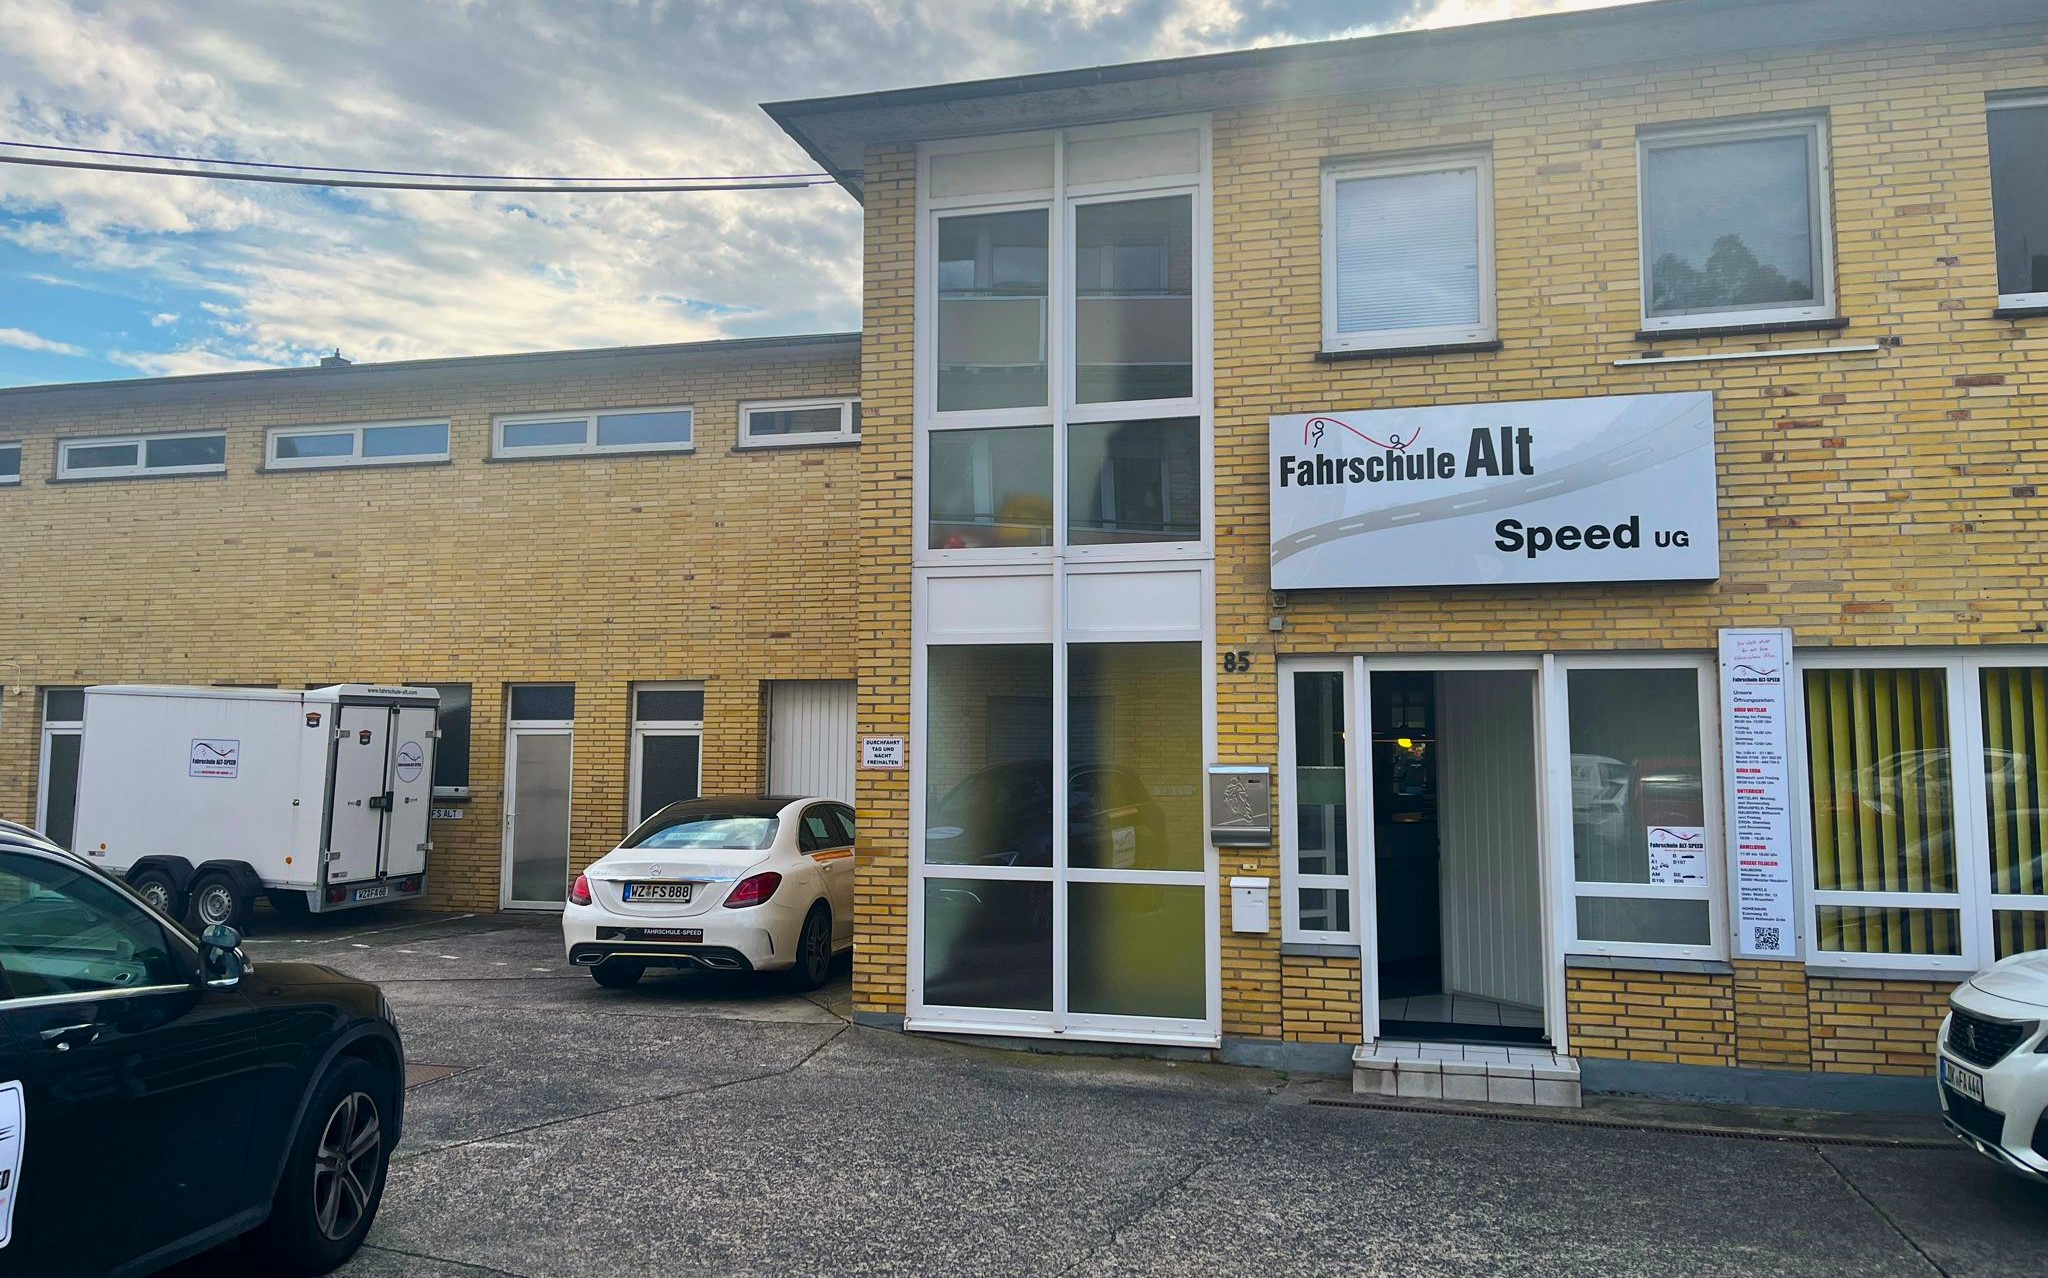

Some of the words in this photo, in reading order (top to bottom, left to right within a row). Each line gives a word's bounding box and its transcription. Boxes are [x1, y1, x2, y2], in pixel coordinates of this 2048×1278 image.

[1280, 447, 1456, 488] Fahrschule
[1465, 426, 1535, 477] Alt
[1495, 516, 1640, 559] Speed
[1655, 530, 1690, 548] UG
[1224, 651, 1250, 672] 85
[444, 809, 457, 817] ALT
[631, 885, 645, 897] WZ
[652, 886, 666, 898] FS
[669, 886, 689, 898] 888
[644, 928, 702, 936] FAHRSCHULE-SPEED
